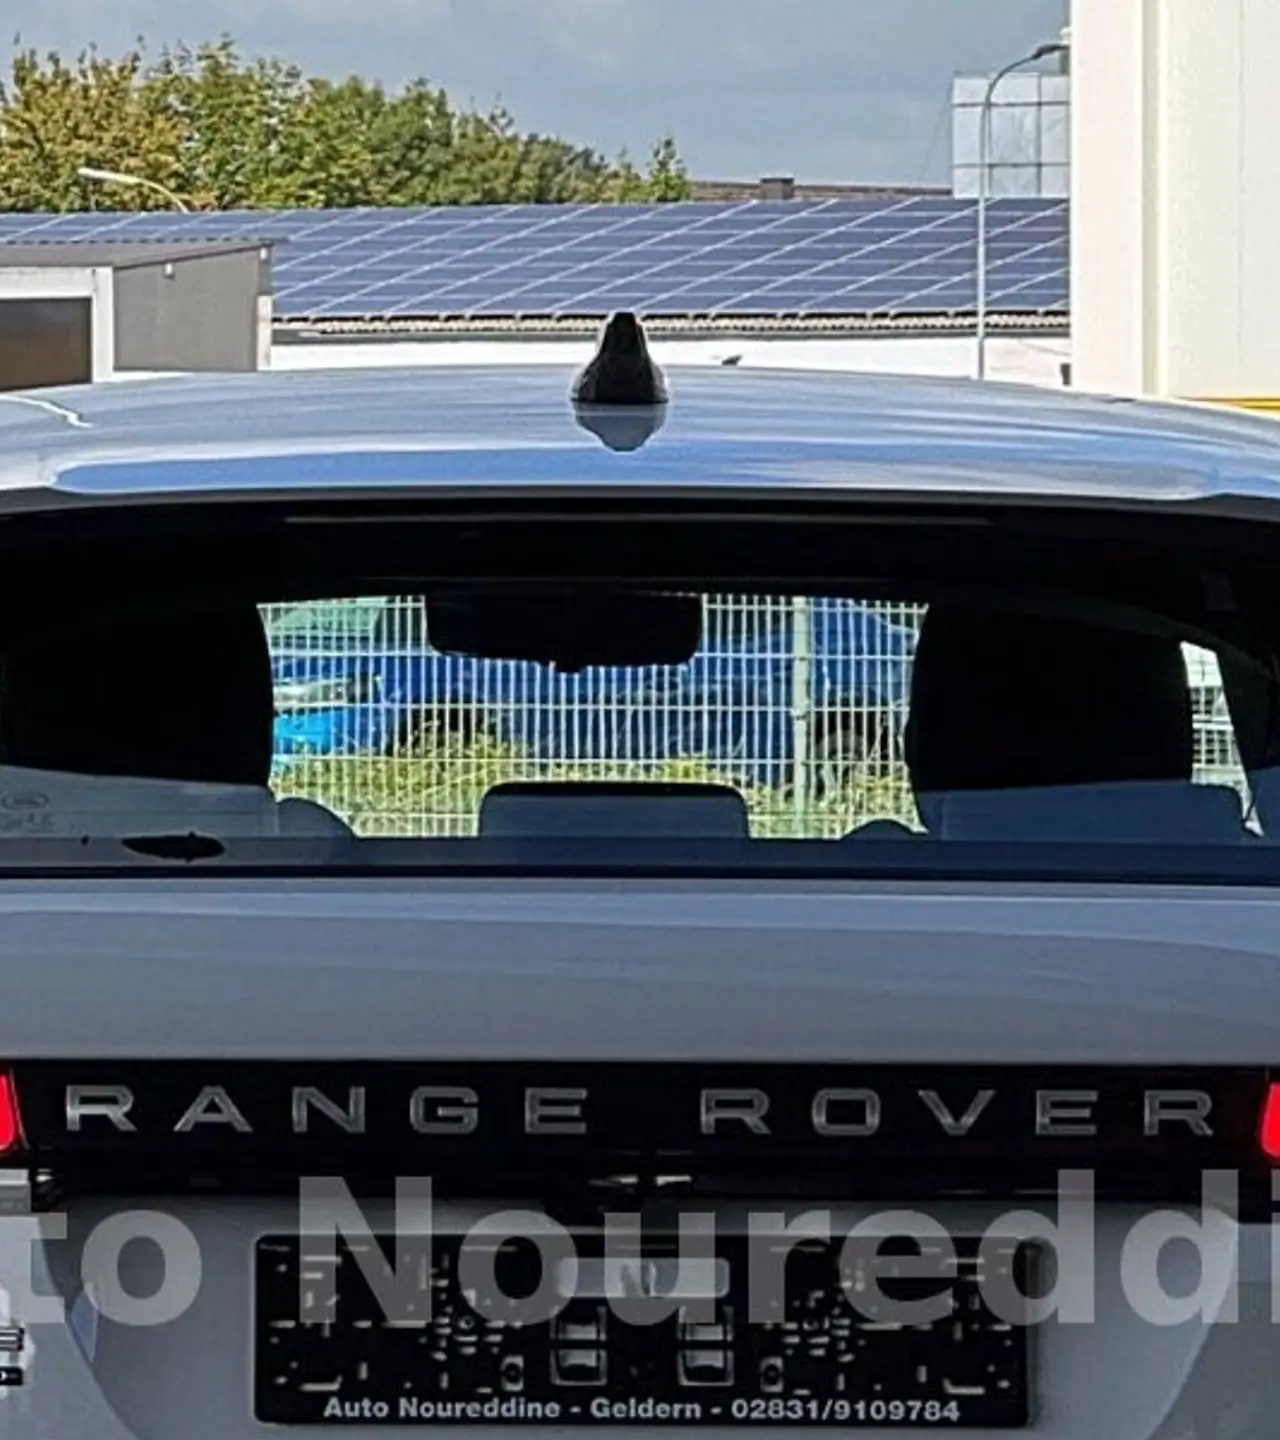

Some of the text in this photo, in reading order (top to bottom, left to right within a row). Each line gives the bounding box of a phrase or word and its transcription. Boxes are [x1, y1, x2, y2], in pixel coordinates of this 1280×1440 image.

[64, 1084, 1216, 1137] RANGE ROVER
[322, 1396, 389, 1419] Auto
[398, 1396, 561, 1419] Noureddine
[589, 1396, 702, 1419] Geldern
[730, 1397, 961, 1421] 02831/9109784
